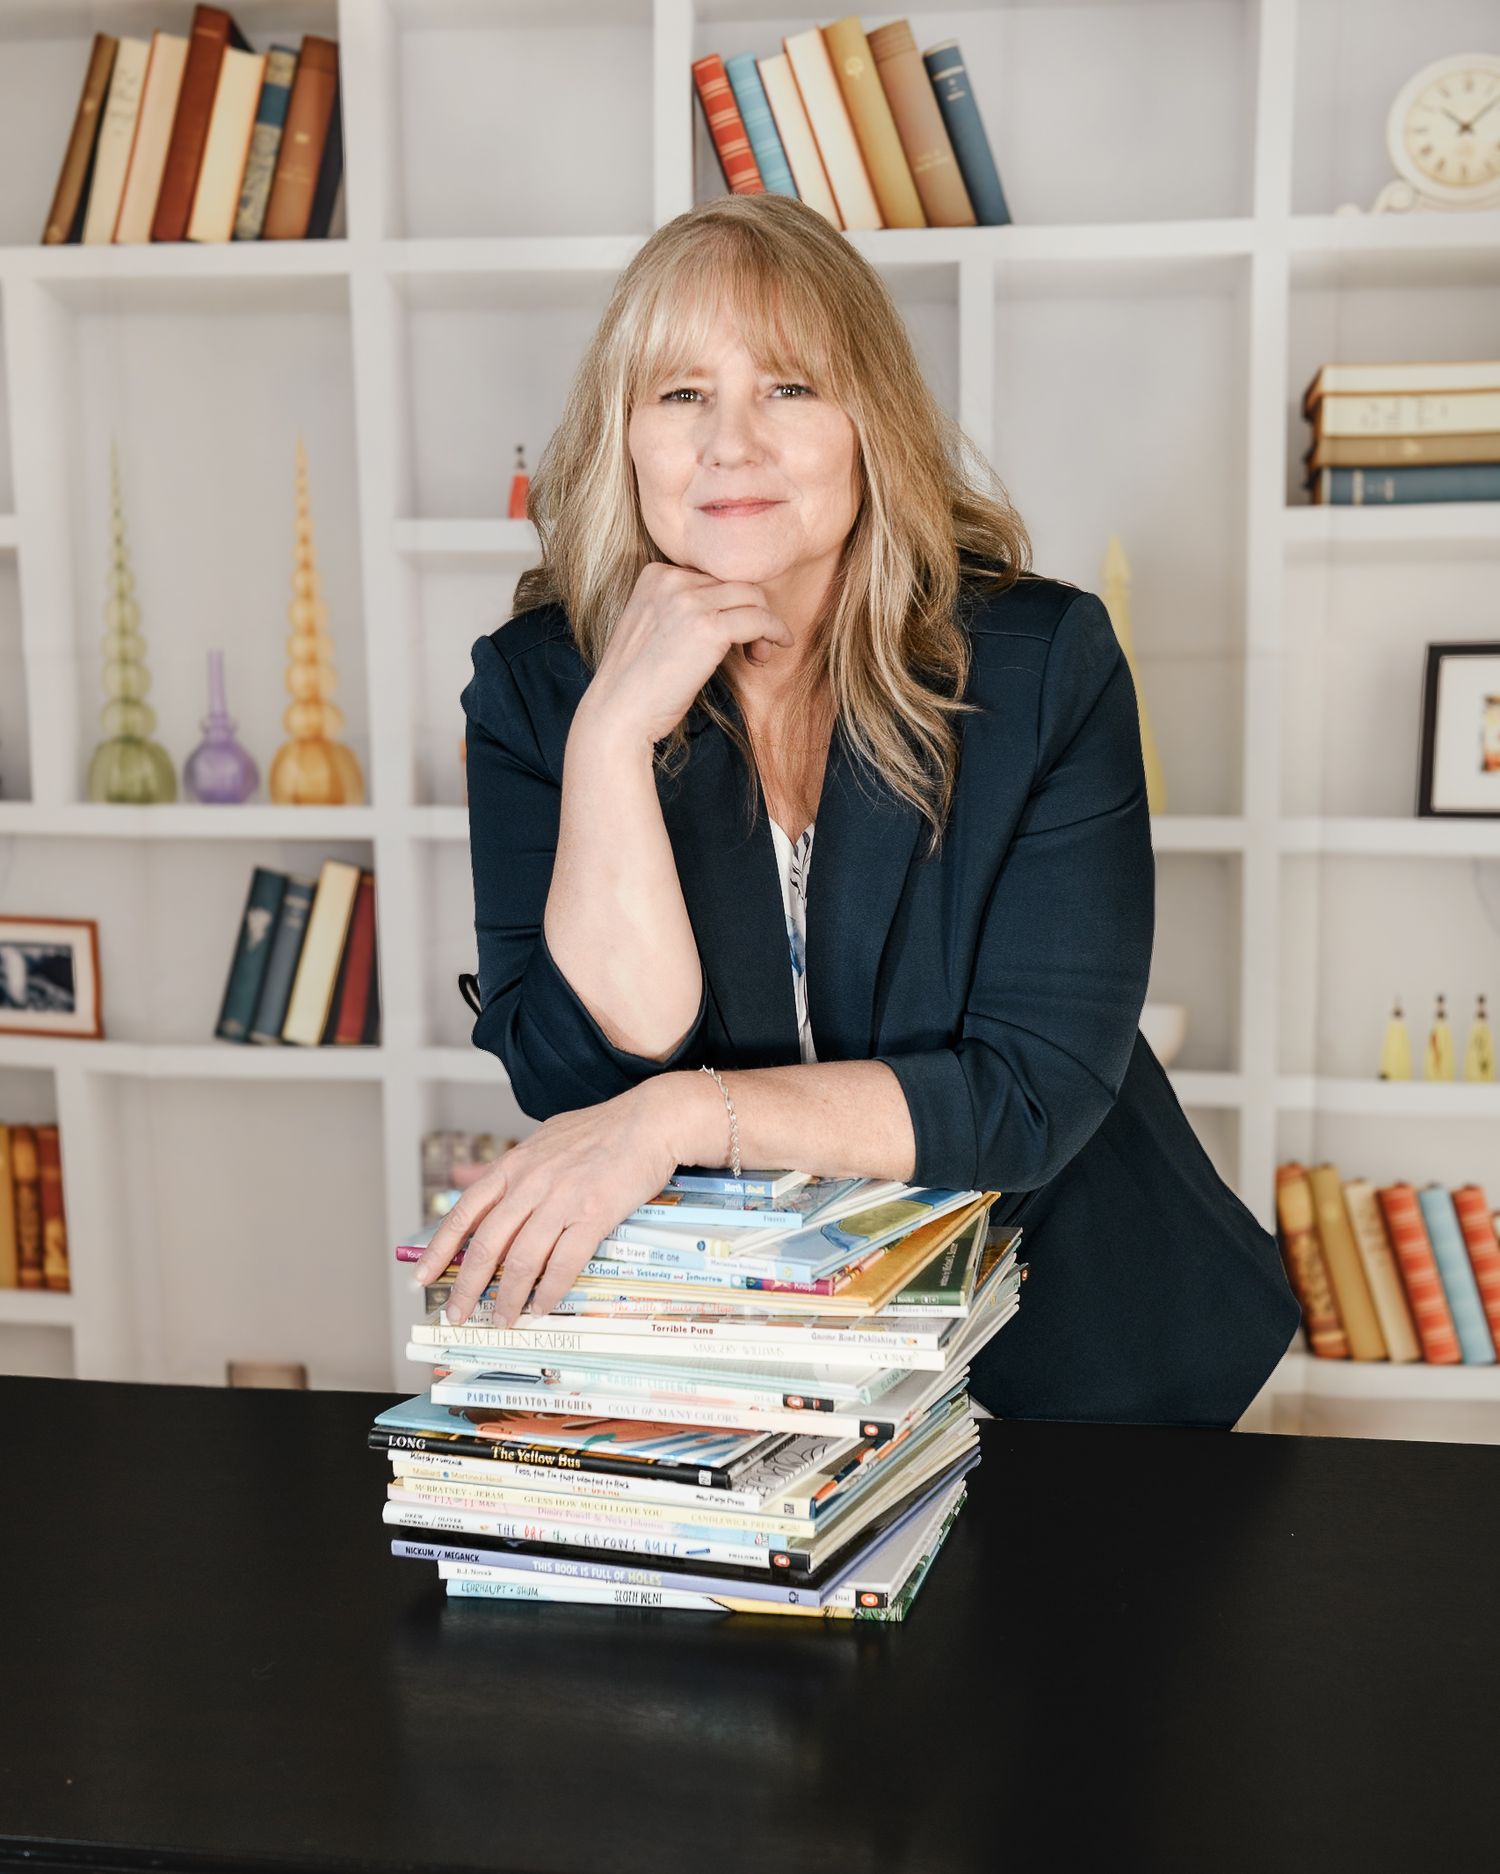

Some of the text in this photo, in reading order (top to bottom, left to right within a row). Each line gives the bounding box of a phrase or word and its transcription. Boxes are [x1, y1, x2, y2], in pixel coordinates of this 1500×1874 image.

[616, 1246, 624, 1256] be
[627, 1247, 646, 1258] brave
[649, 1248, 665, 1261] little
[667, 1254, 681, 1264] one
[588, 1264, 618, 1277] School
[636, 1268, 671, 1280] Yesterday
[686, 1273, 722, 1283] Tomorrow
[453, 1329, 530, 1347] VELVETEEN
[535, 1331, 583, 1350] RABBIT
[691, 1325, 714, 1336] Puns
[839, 1333, 856, 1343] Road
[859, 1334, 897, 1346] Publishing
[467, 1393, 503, 1404] PARTON
[506, 1395, 593, 1411] BOYNTON-HUGHES
[609, 1404, 637, 1414] COAT
[658, 1408, 691, 1419] MANY
[695, 1412, 739, 1423] COLORS
[388, 1435, 581, 1469] LONG The Yellow Bus
[560, 1473, 574, 1484] that
[474, 1490, 504, 1501] JERAM
[523, 1495, 553, 1505] GUESS
[556, 1498, 577, 1508] HOW
[581, 1501, 608, 1511] MUCH
[615, 1504, 639, 1514] LOVE
[643, 1508, 662, 1517] YOU
[691, 1513, 750, 1527] CANDLEWICK
[497, 1523, 516, 1537] THE
[525, 1524, 544, 1540] DAY
[574, 1533, 636, 1552] CRAYONS
[645, 1538, 677, 1556] QUIT
[405, 1546, 434, 1557] NICKUM
[444, 1550, 480, 1562] MEGANCK
[532, 1560, 553, 1573] THIS
[555, 1563, 578, 1575] BOOK
[580, 1566, 589, 1576] IS
[592, 1567, 611, 1580] FULL
[614, 1570, 625, 1581] OF
[628, 1571, 662, 1585] HOLES
[614, 1590, 638, 1604] SLOTH
[640, 1591, 663, 1605] WENT
